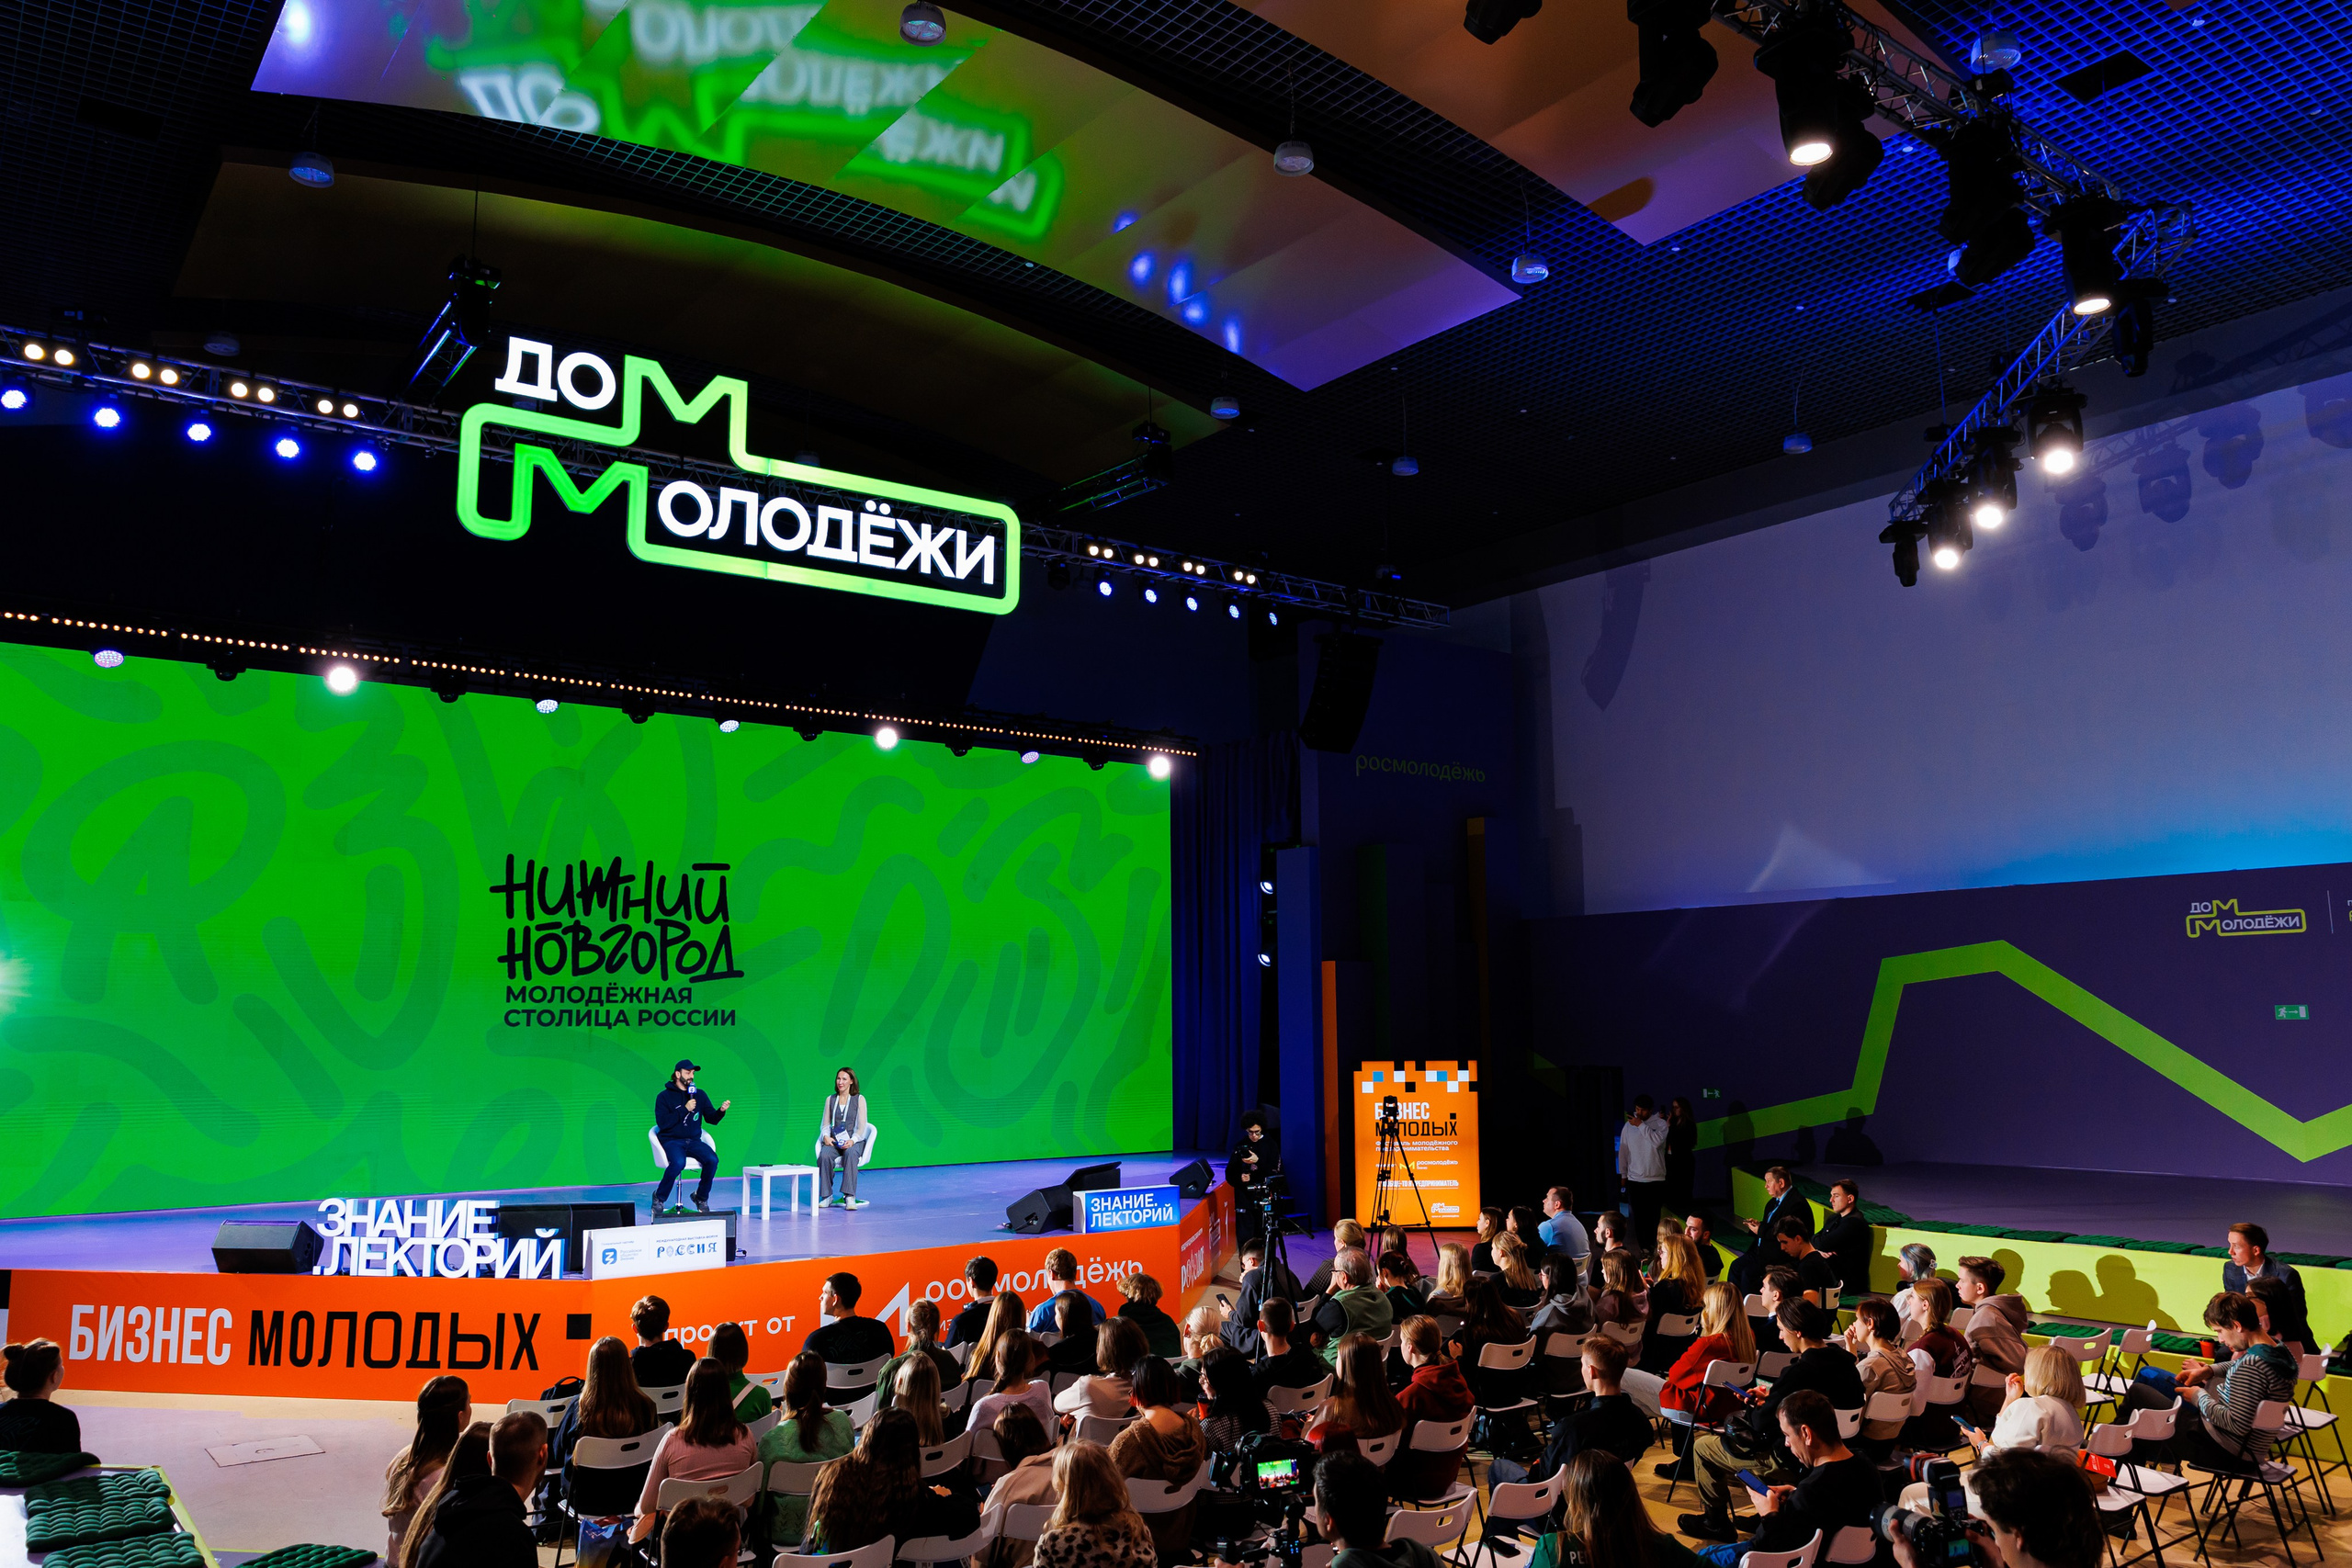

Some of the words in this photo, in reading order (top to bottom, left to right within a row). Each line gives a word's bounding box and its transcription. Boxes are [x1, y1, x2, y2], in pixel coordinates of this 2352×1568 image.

[1355, 754, 1486, 782] росмолодёжь
[489, 853, 731, 924] НИЖНИЙ
[497, 919, 745, 984] НОВГОРОД
[505, 982, 692, 1007] МОЛОДЁЖНАЯ
[503, 1010, 630, 1029] СТОЛИЦА
[638, 1009, 736, 1027] РОССИИ
[1374, 1102, 1430, 1120] БЗНЕС
[1375, 1122, 1458, 1136] МЛОДЫХ
[1090, 1203, 1173, 1227] ЛЕКТОРИЙ
[1091, 1192, 1158, 1213] ЗНАНИЕ.
[316, 1197, 500, 1239] ЗНАНИЕ
[656, 1242, 718, 1258] РОССИЯ
[68, 1304, 233, 1366] БИЗНЕС
[248, 1310, 541, 1371] МОЛОДЫХ
[664, 1320, 758, 1349] прот
[766, 1315, 796, 1335] от
